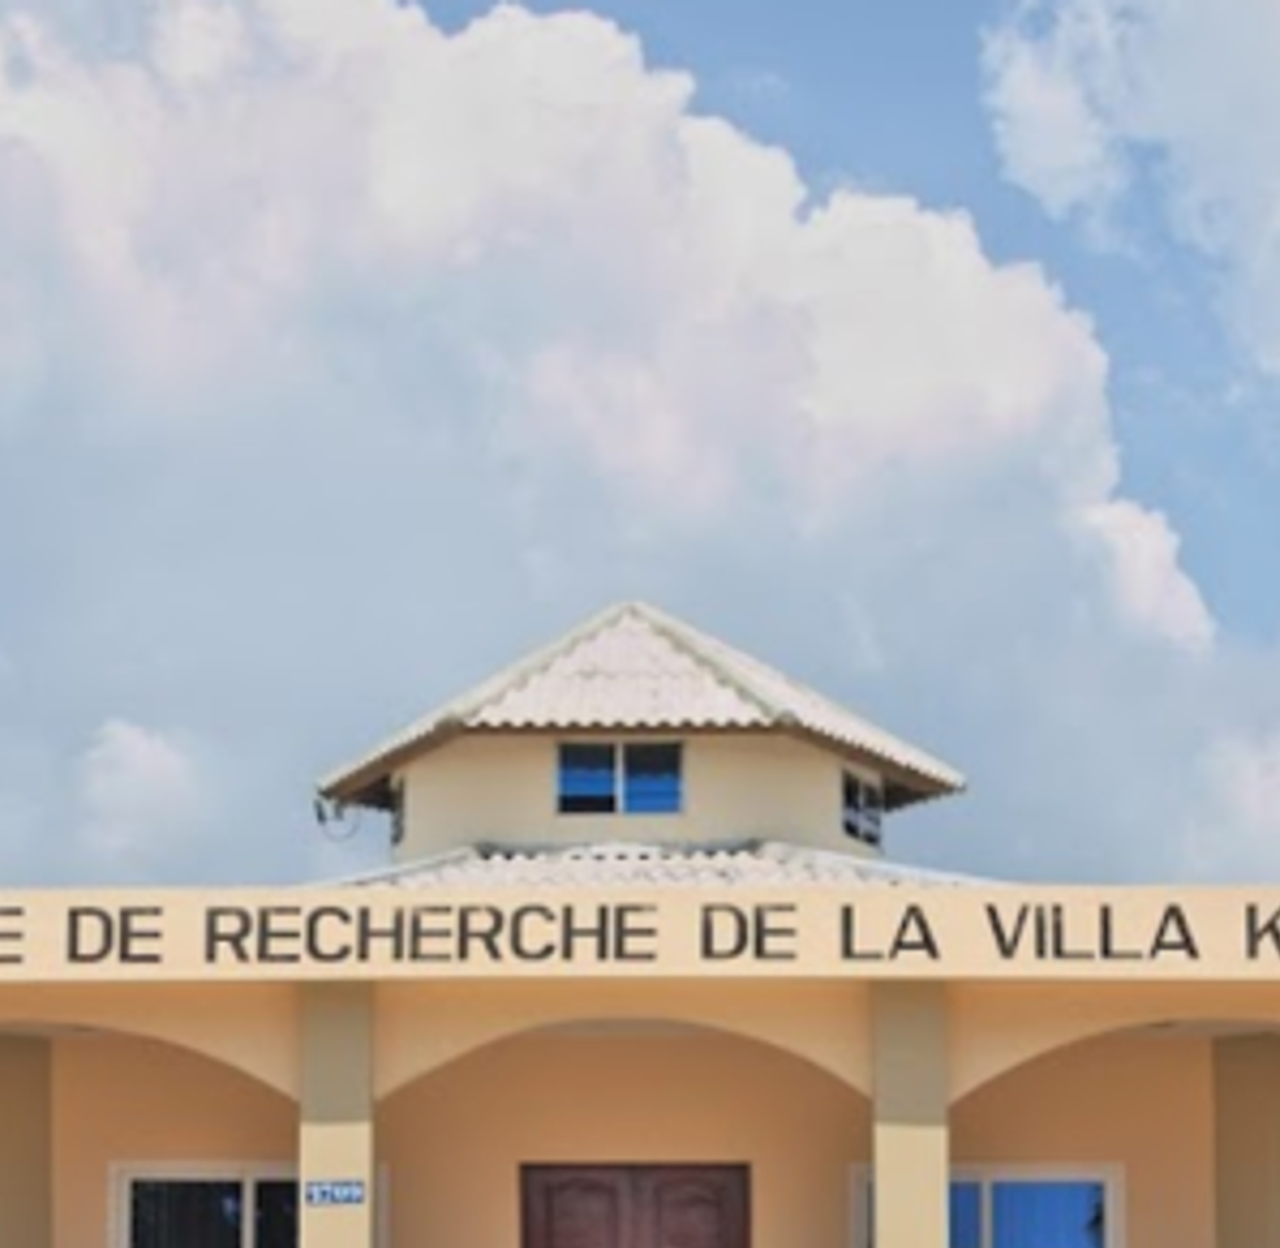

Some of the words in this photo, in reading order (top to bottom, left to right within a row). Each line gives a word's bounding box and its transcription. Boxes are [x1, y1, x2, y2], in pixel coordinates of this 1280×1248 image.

[66, 905, 162, 964] DE
[204, 903, 657, 964] RECHERCHE
[699, 903, 796, 961] DE
[839, 903, 940, 961] LA
[985, 902, 1199, 961] VILLA
